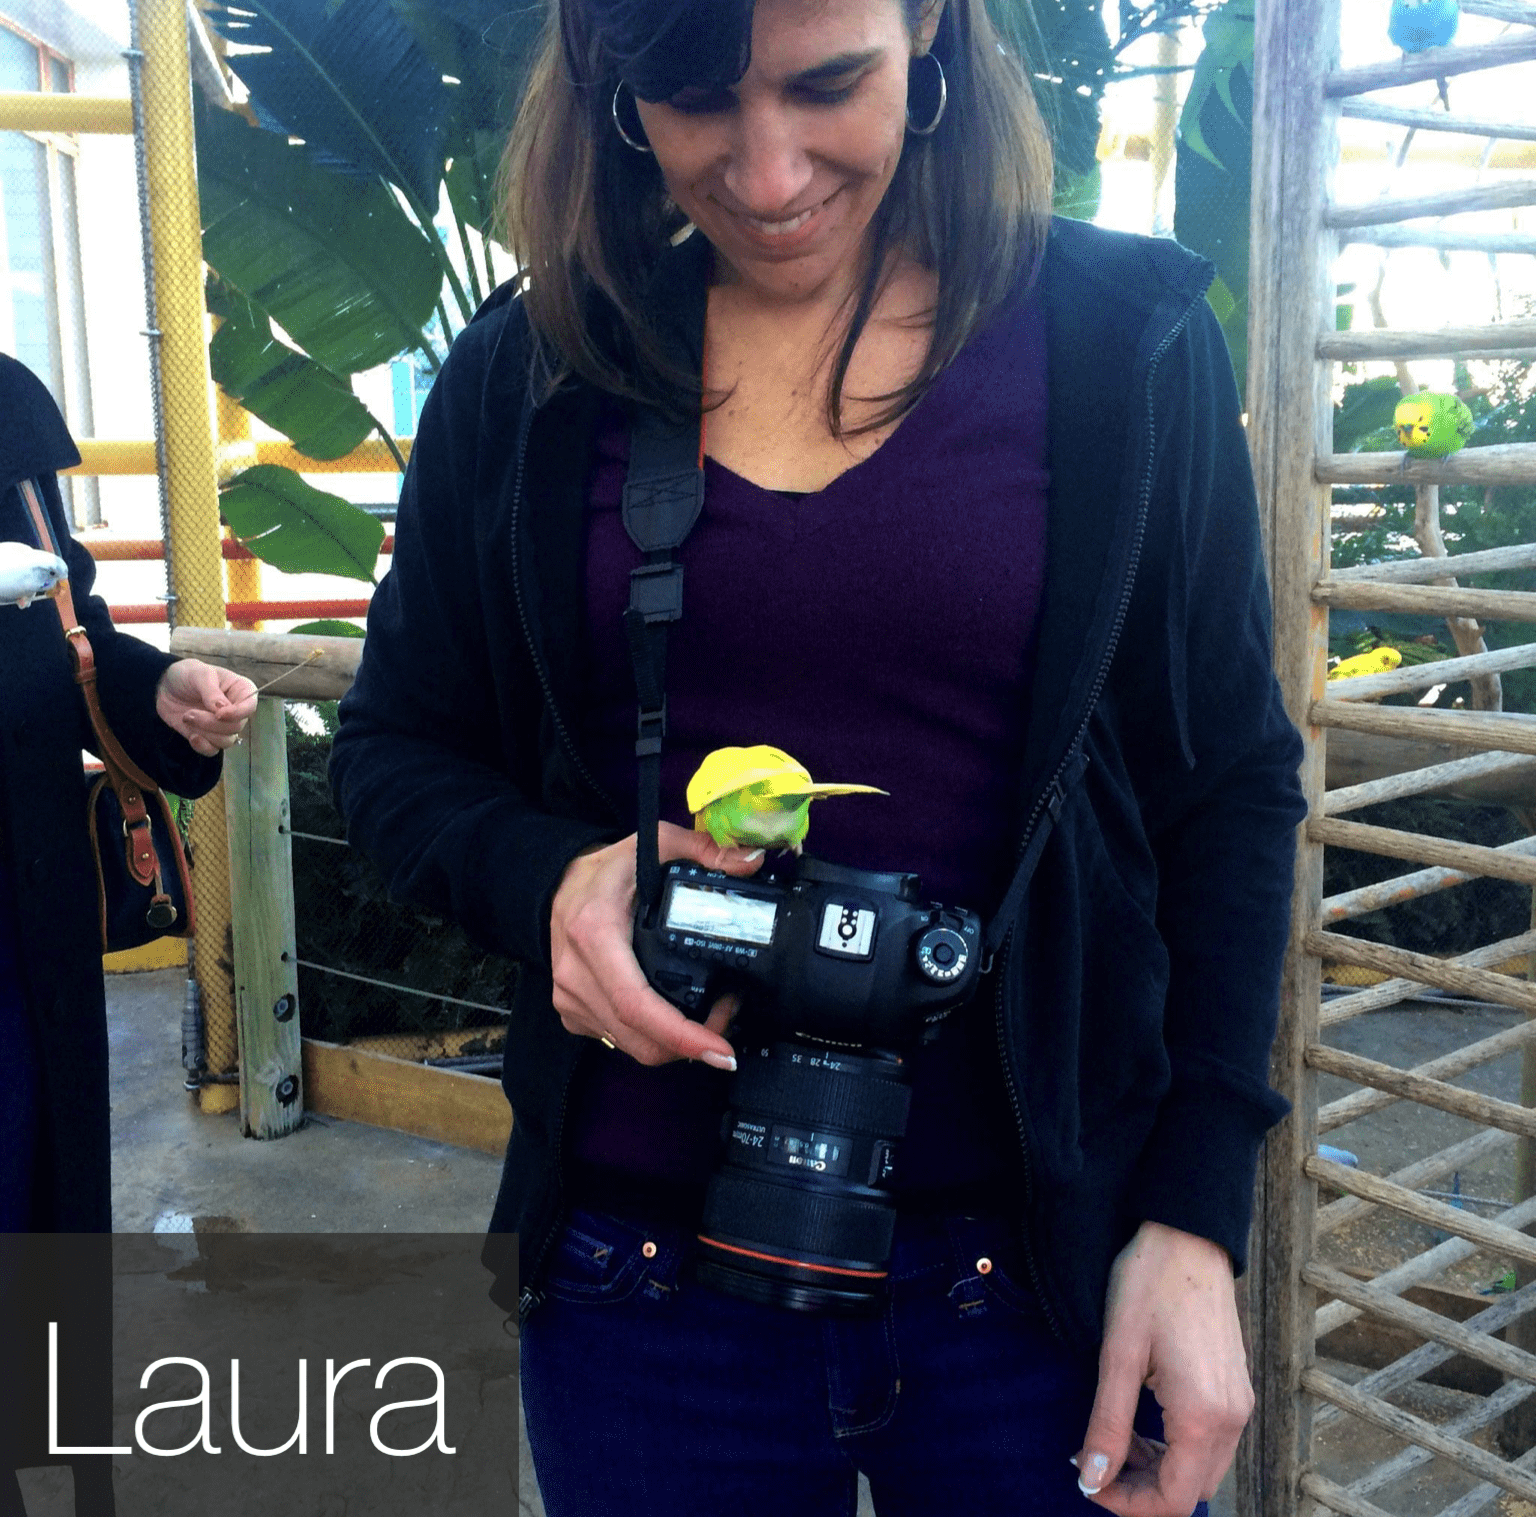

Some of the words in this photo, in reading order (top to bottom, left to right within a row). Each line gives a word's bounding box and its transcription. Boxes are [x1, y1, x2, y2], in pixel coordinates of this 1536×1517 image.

[792, 1054, 802, 1063] 35
[810, 1057, 821, 1067] 28
[788, 1155, 827, 1171] Canon
